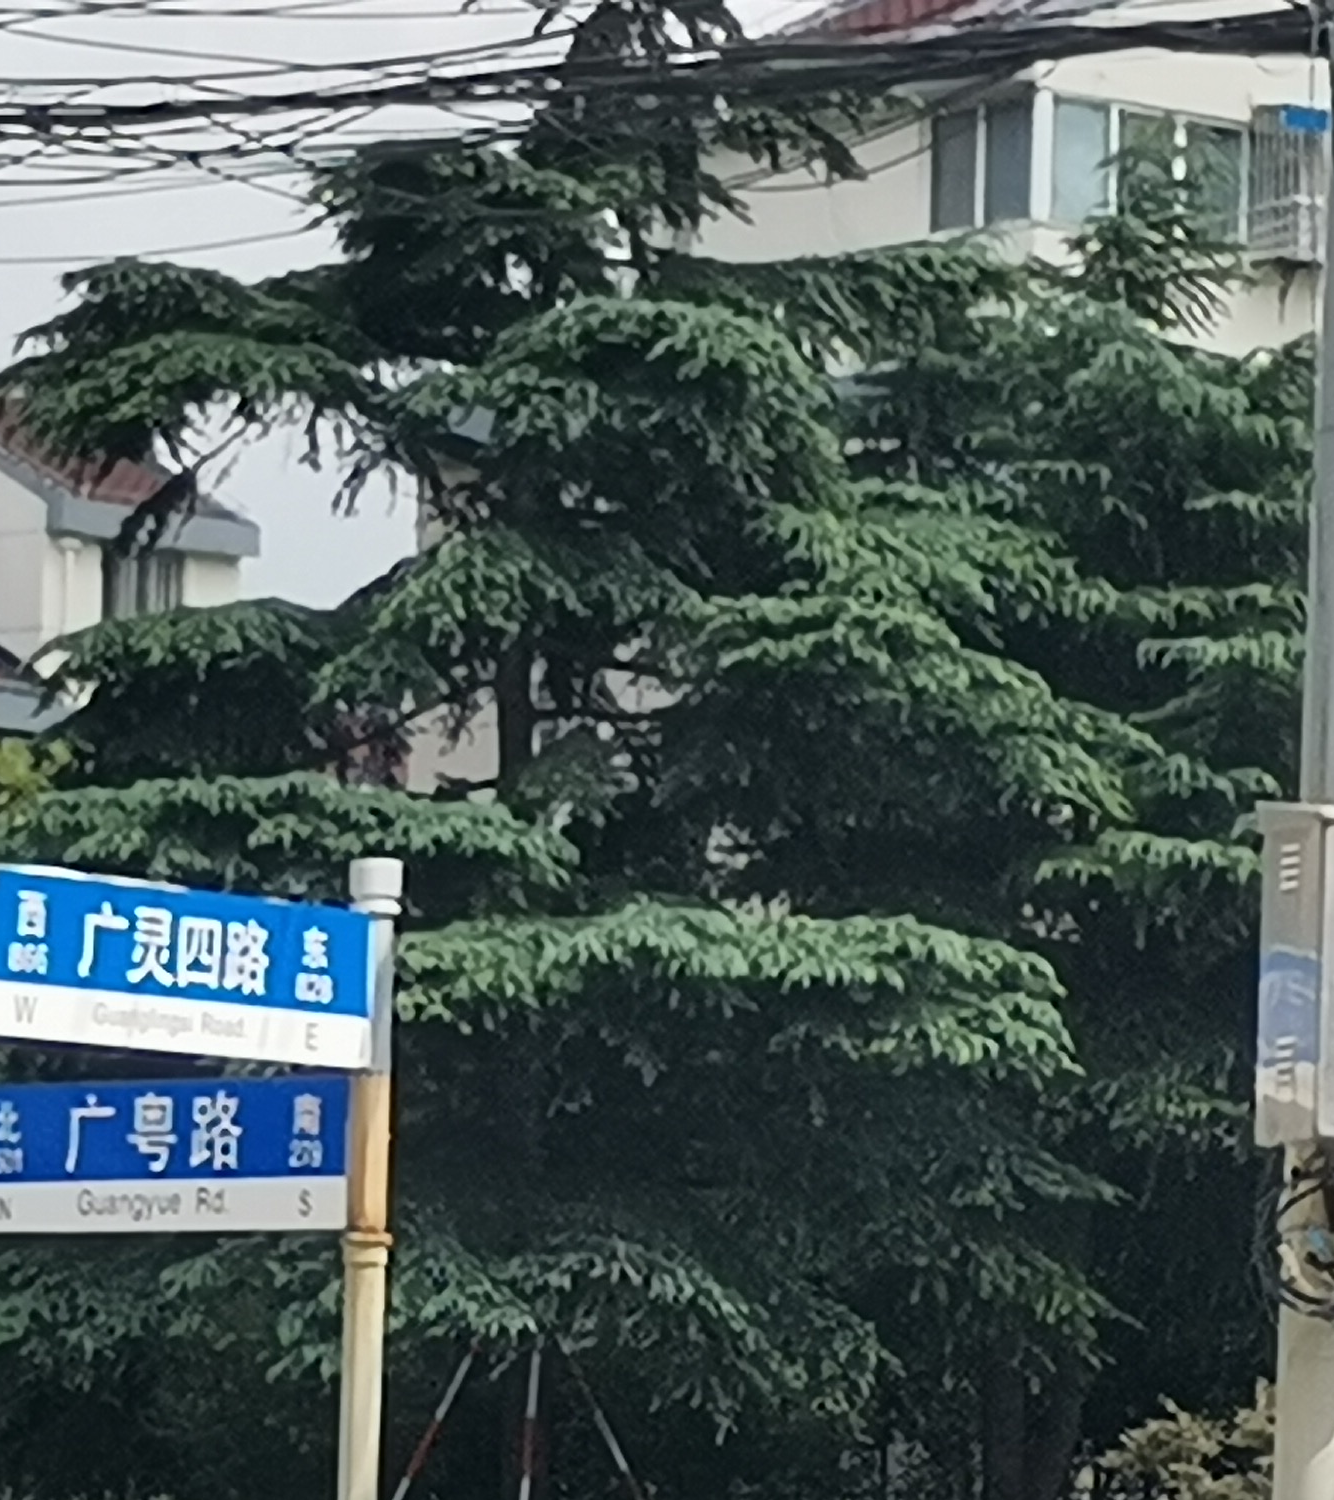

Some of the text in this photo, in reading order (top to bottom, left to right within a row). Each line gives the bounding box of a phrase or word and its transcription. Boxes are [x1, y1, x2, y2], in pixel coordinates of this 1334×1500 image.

[77, 901, 269, 996] 广灵四路
[13, 996, 38, 1024] W
[304, 1022, 319, 1051] E
[65, 1089, 243, 1174] 广粤路
[77, 1187, 181, 1222] Guangyue
[297, 1188, 313, 1218] S
